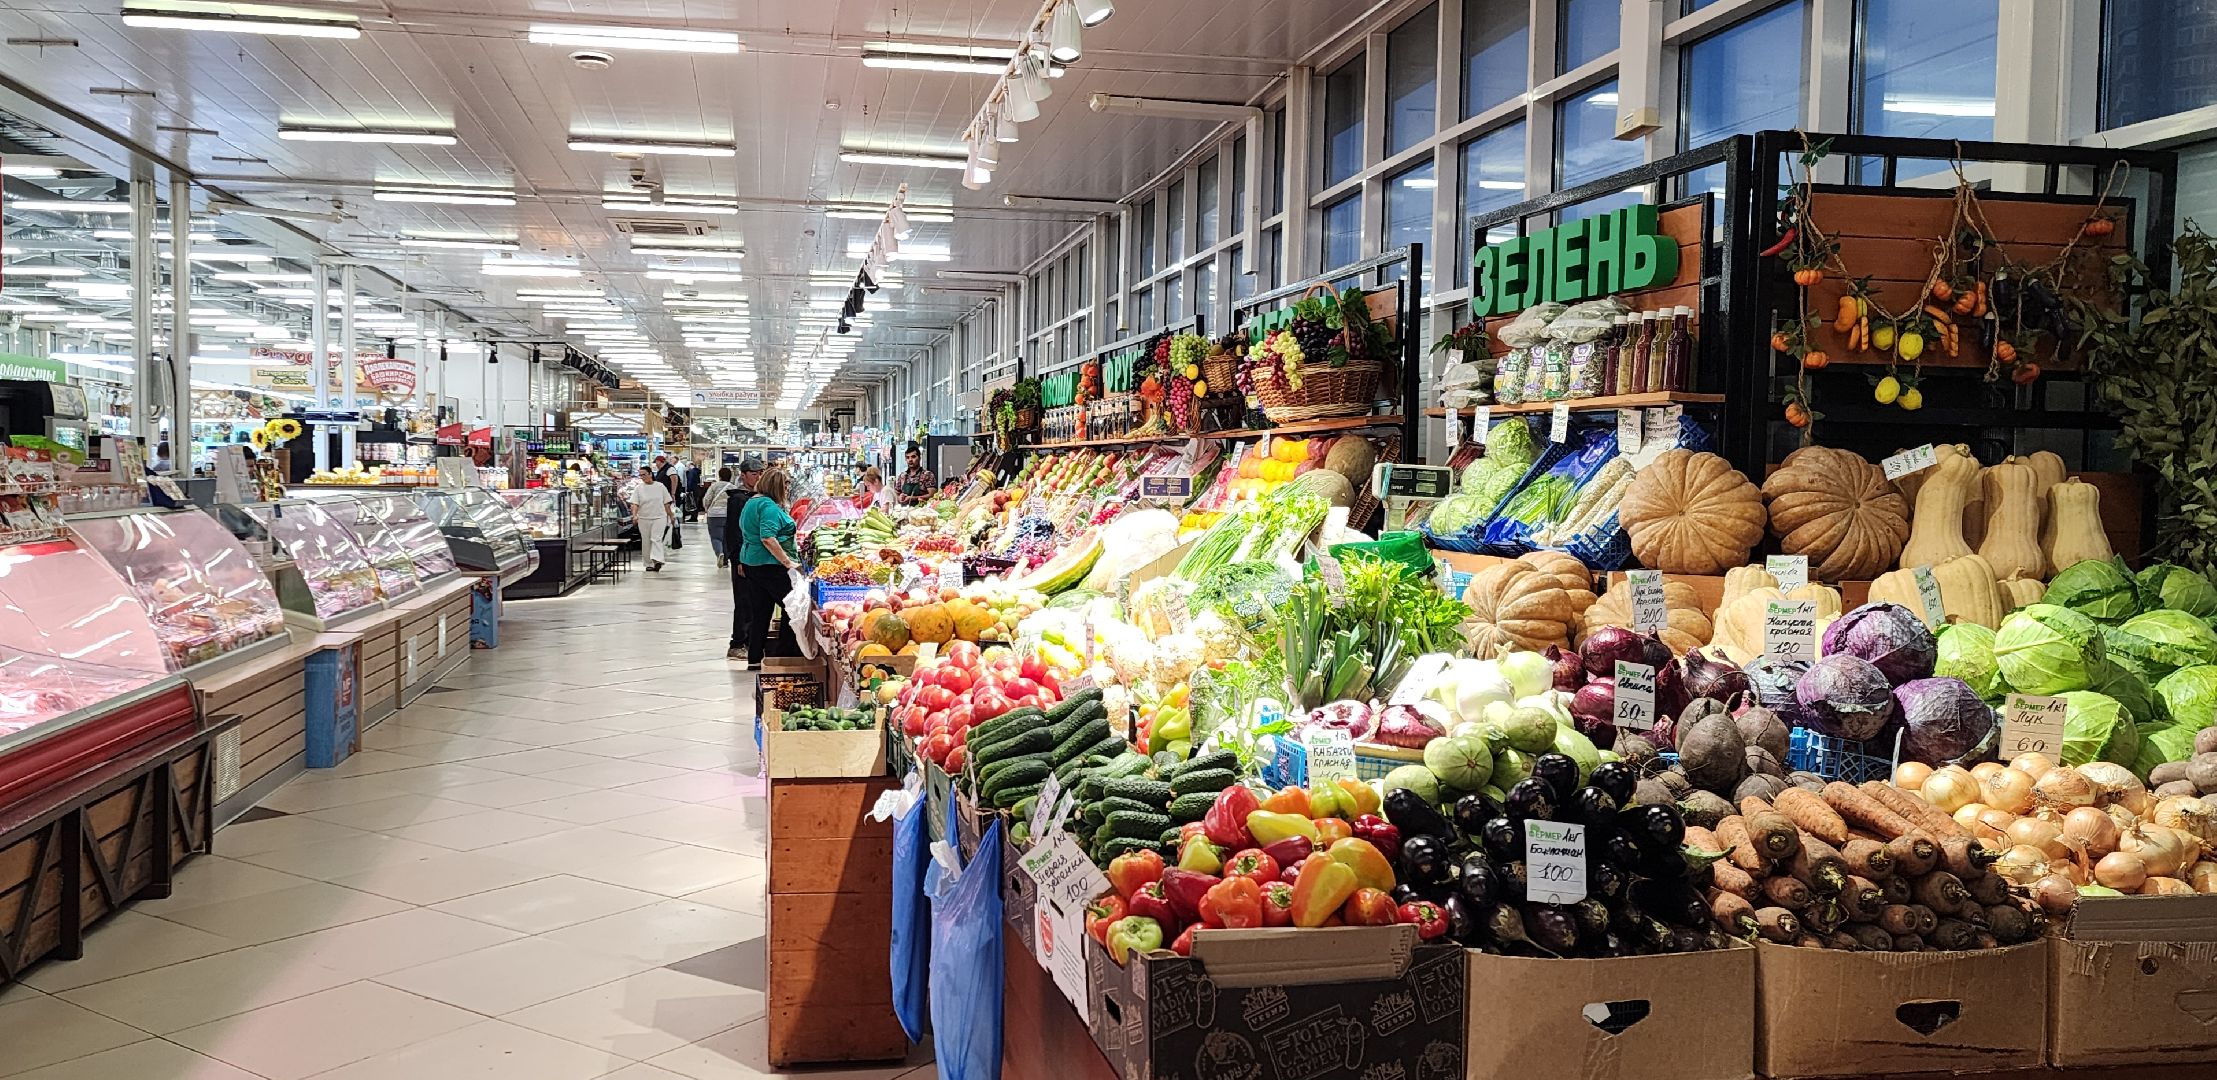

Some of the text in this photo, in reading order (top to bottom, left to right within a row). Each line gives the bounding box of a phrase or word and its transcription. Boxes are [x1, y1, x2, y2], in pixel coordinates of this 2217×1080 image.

[1473, 204, 1679, 317] ЗЕЛЕНЬ
[1041, 372, 1078, 408] ОВОЩИ
[1641, 608, 1663, 624] 200
[1797, 602, 1815, 613] 1кг
[1766, 616, 1815, 630] Капуста
[1773, 641, 1800, 653] 120
[2013, 700, 2068, 712] ФЕРМЕР 1кг
[2010, 711, 2044, 726] Лук
[1528, 827, 1583, 843] ФЕРМЕР 1кг
[1538, 862, 1573, 881] 100
[1066, 876, 1088, 901] 100
[1287, 1020, 1323, 1046] ТОТ
[1279, 1029, 1343, 1069] САМЫЙ
[1286, 1048, 1341, 1079] ОГУРЕЦ
